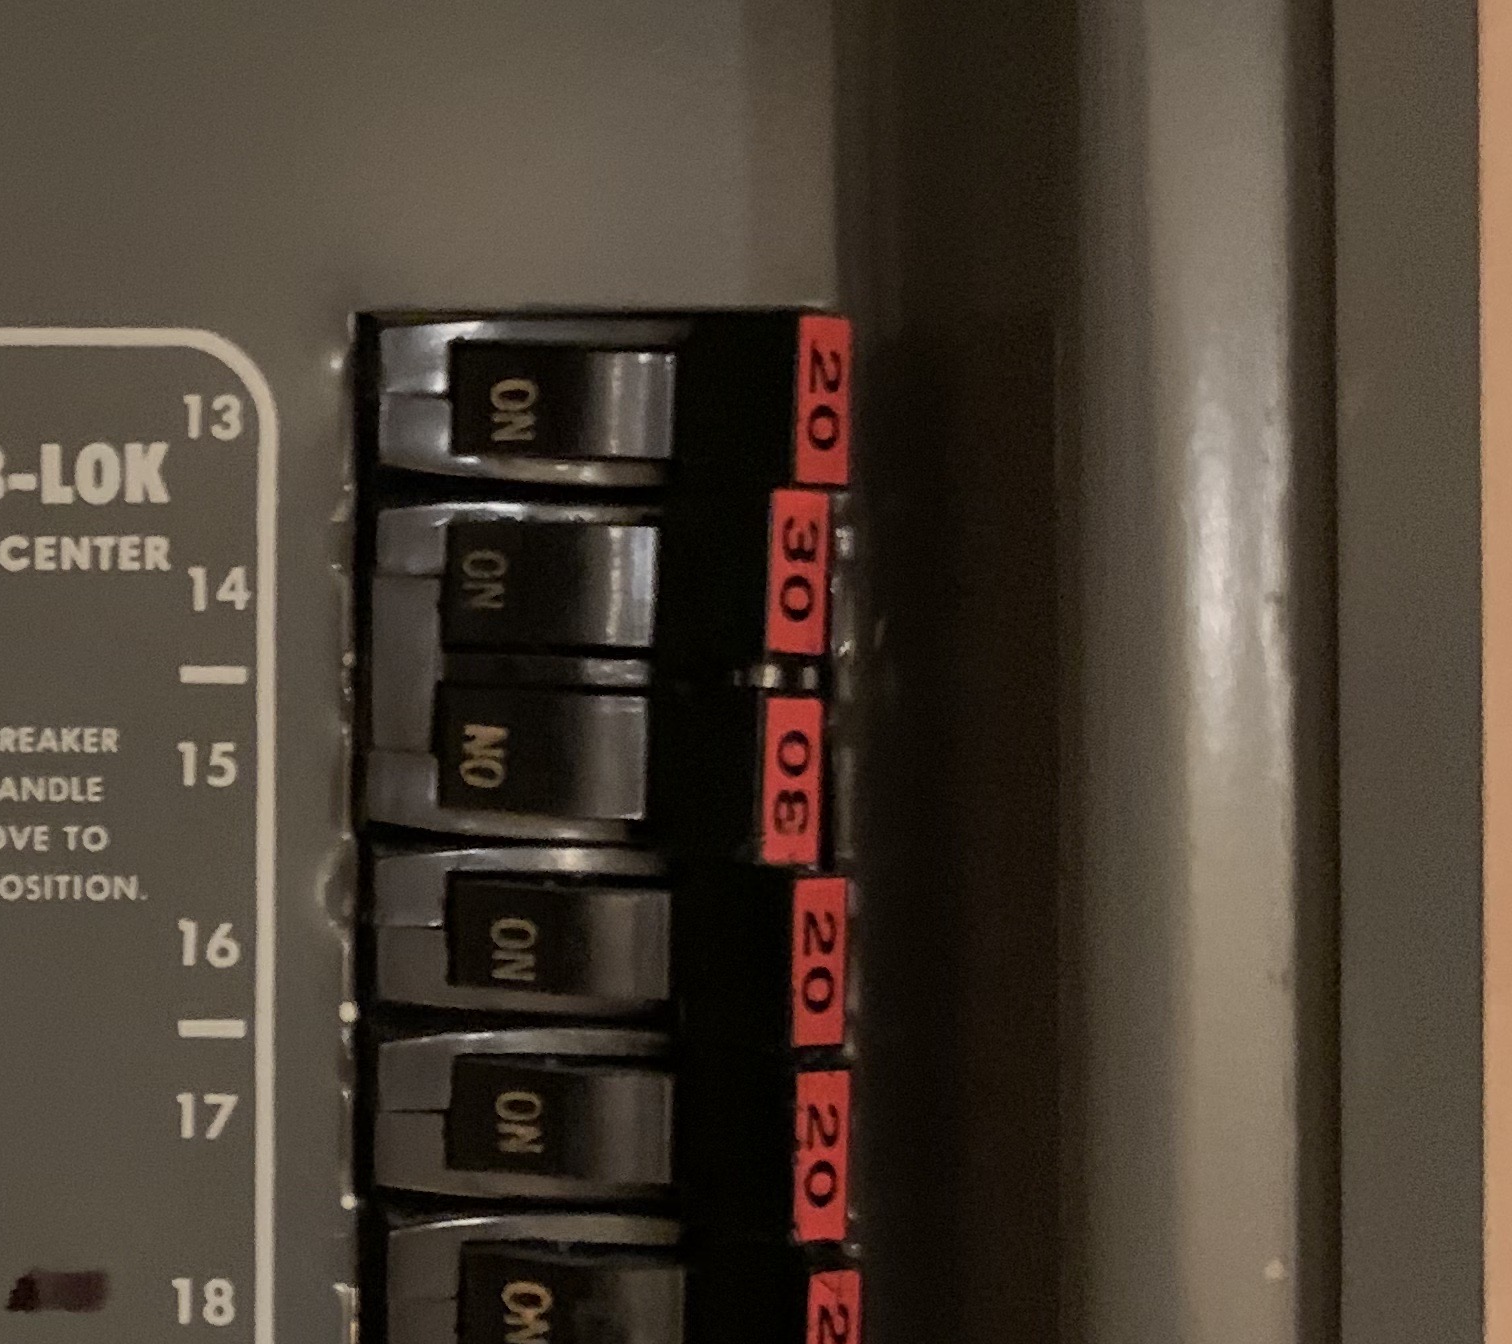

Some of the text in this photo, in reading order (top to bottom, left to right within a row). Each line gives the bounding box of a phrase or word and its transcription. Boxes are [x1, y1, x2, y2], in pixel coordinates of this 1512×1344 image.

[183, 394, 241, 440] 13
[490, 379, 536, 441] ON
[807, 341, 841, 451] 20
[188, 567, 251, 612] 14
[462, 550, 508, 611] ON
[779, 518, 818, 622] 30
[178, 742, 237, 788] 15
[460, 723, 509, 788] ON
[774, 730, 811, 835] 30
[62, 825, 109, 851] TO
[178, 918, 240, 968] 16
[491, 918, 536, 981] ON
[801, 912, 837, 1014] 20
[176, 1092, 238, 1139] 17
[495, 1091, 545, 1154] ON
[803, 1104, 838, 1208] 20
[171, 1278, 235, 1325] 18
